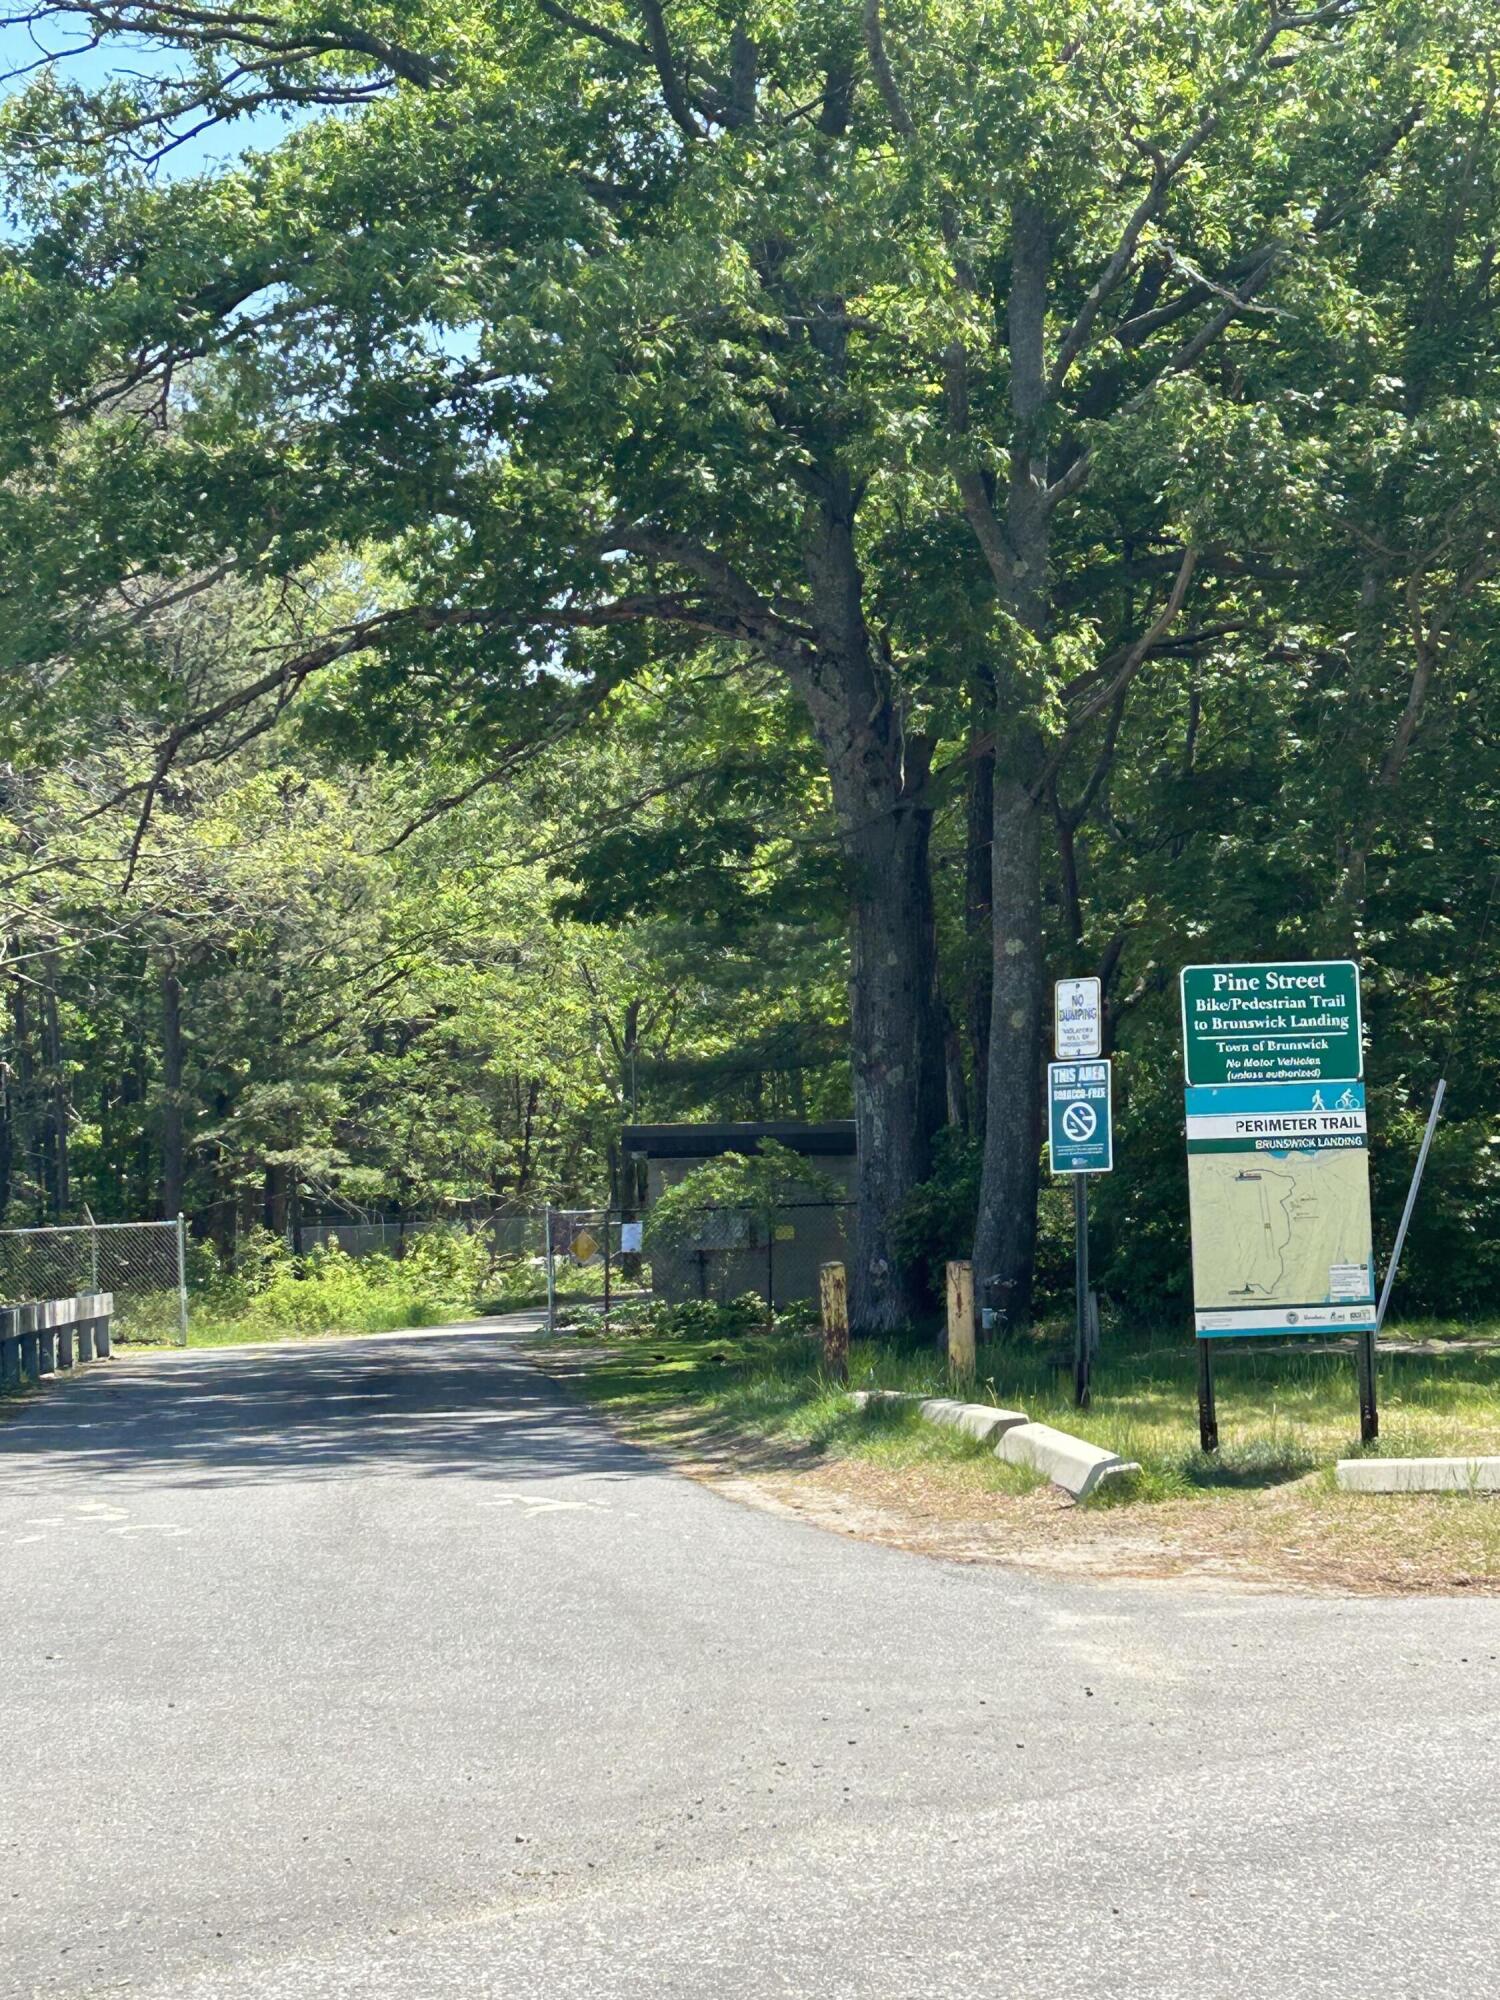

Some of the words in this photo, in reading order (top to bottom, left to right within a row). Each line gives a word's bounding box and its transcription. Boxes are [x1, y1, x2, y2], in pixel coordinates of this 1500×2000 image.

[1213, 973, 1260, 991] Pine
[1265, 972, 1327, 990] Street
[1071, 994, 1084, 1007] NO
[1195, 996, 1306, 1012] Bike/Pedestrian
[1309, 994, 1346, 1008] Trail
[1194, 1020, 1208, 1030] to
[1212, 1015, 1287, 1030] Brunswick
[1291, 1014, 1350, 1030] Landing
[1216, 1041, 1249, 1053] Town
[1252, 1040, 1266, 1052] of
[1267, 1038, 1329, 1051] Brunswick
[1226, 1058, 1241, 1068] No
[1243, 1057, 1275, 1067] Motor
[1277, 1056, 1321, 1066] Vehicles
[1053, 1067, 1076, 1083] THIS
[1078, 1065, 1106, 1081] AREA
[1236, 1118, 1317, 1133] PERIMETER
[1320, 1116, 1362, 1130] TRAIL
[1255, 1137, 1317, 1150] BRUNSWICK
[1318, 1136, 1363, 1148] LANDING
